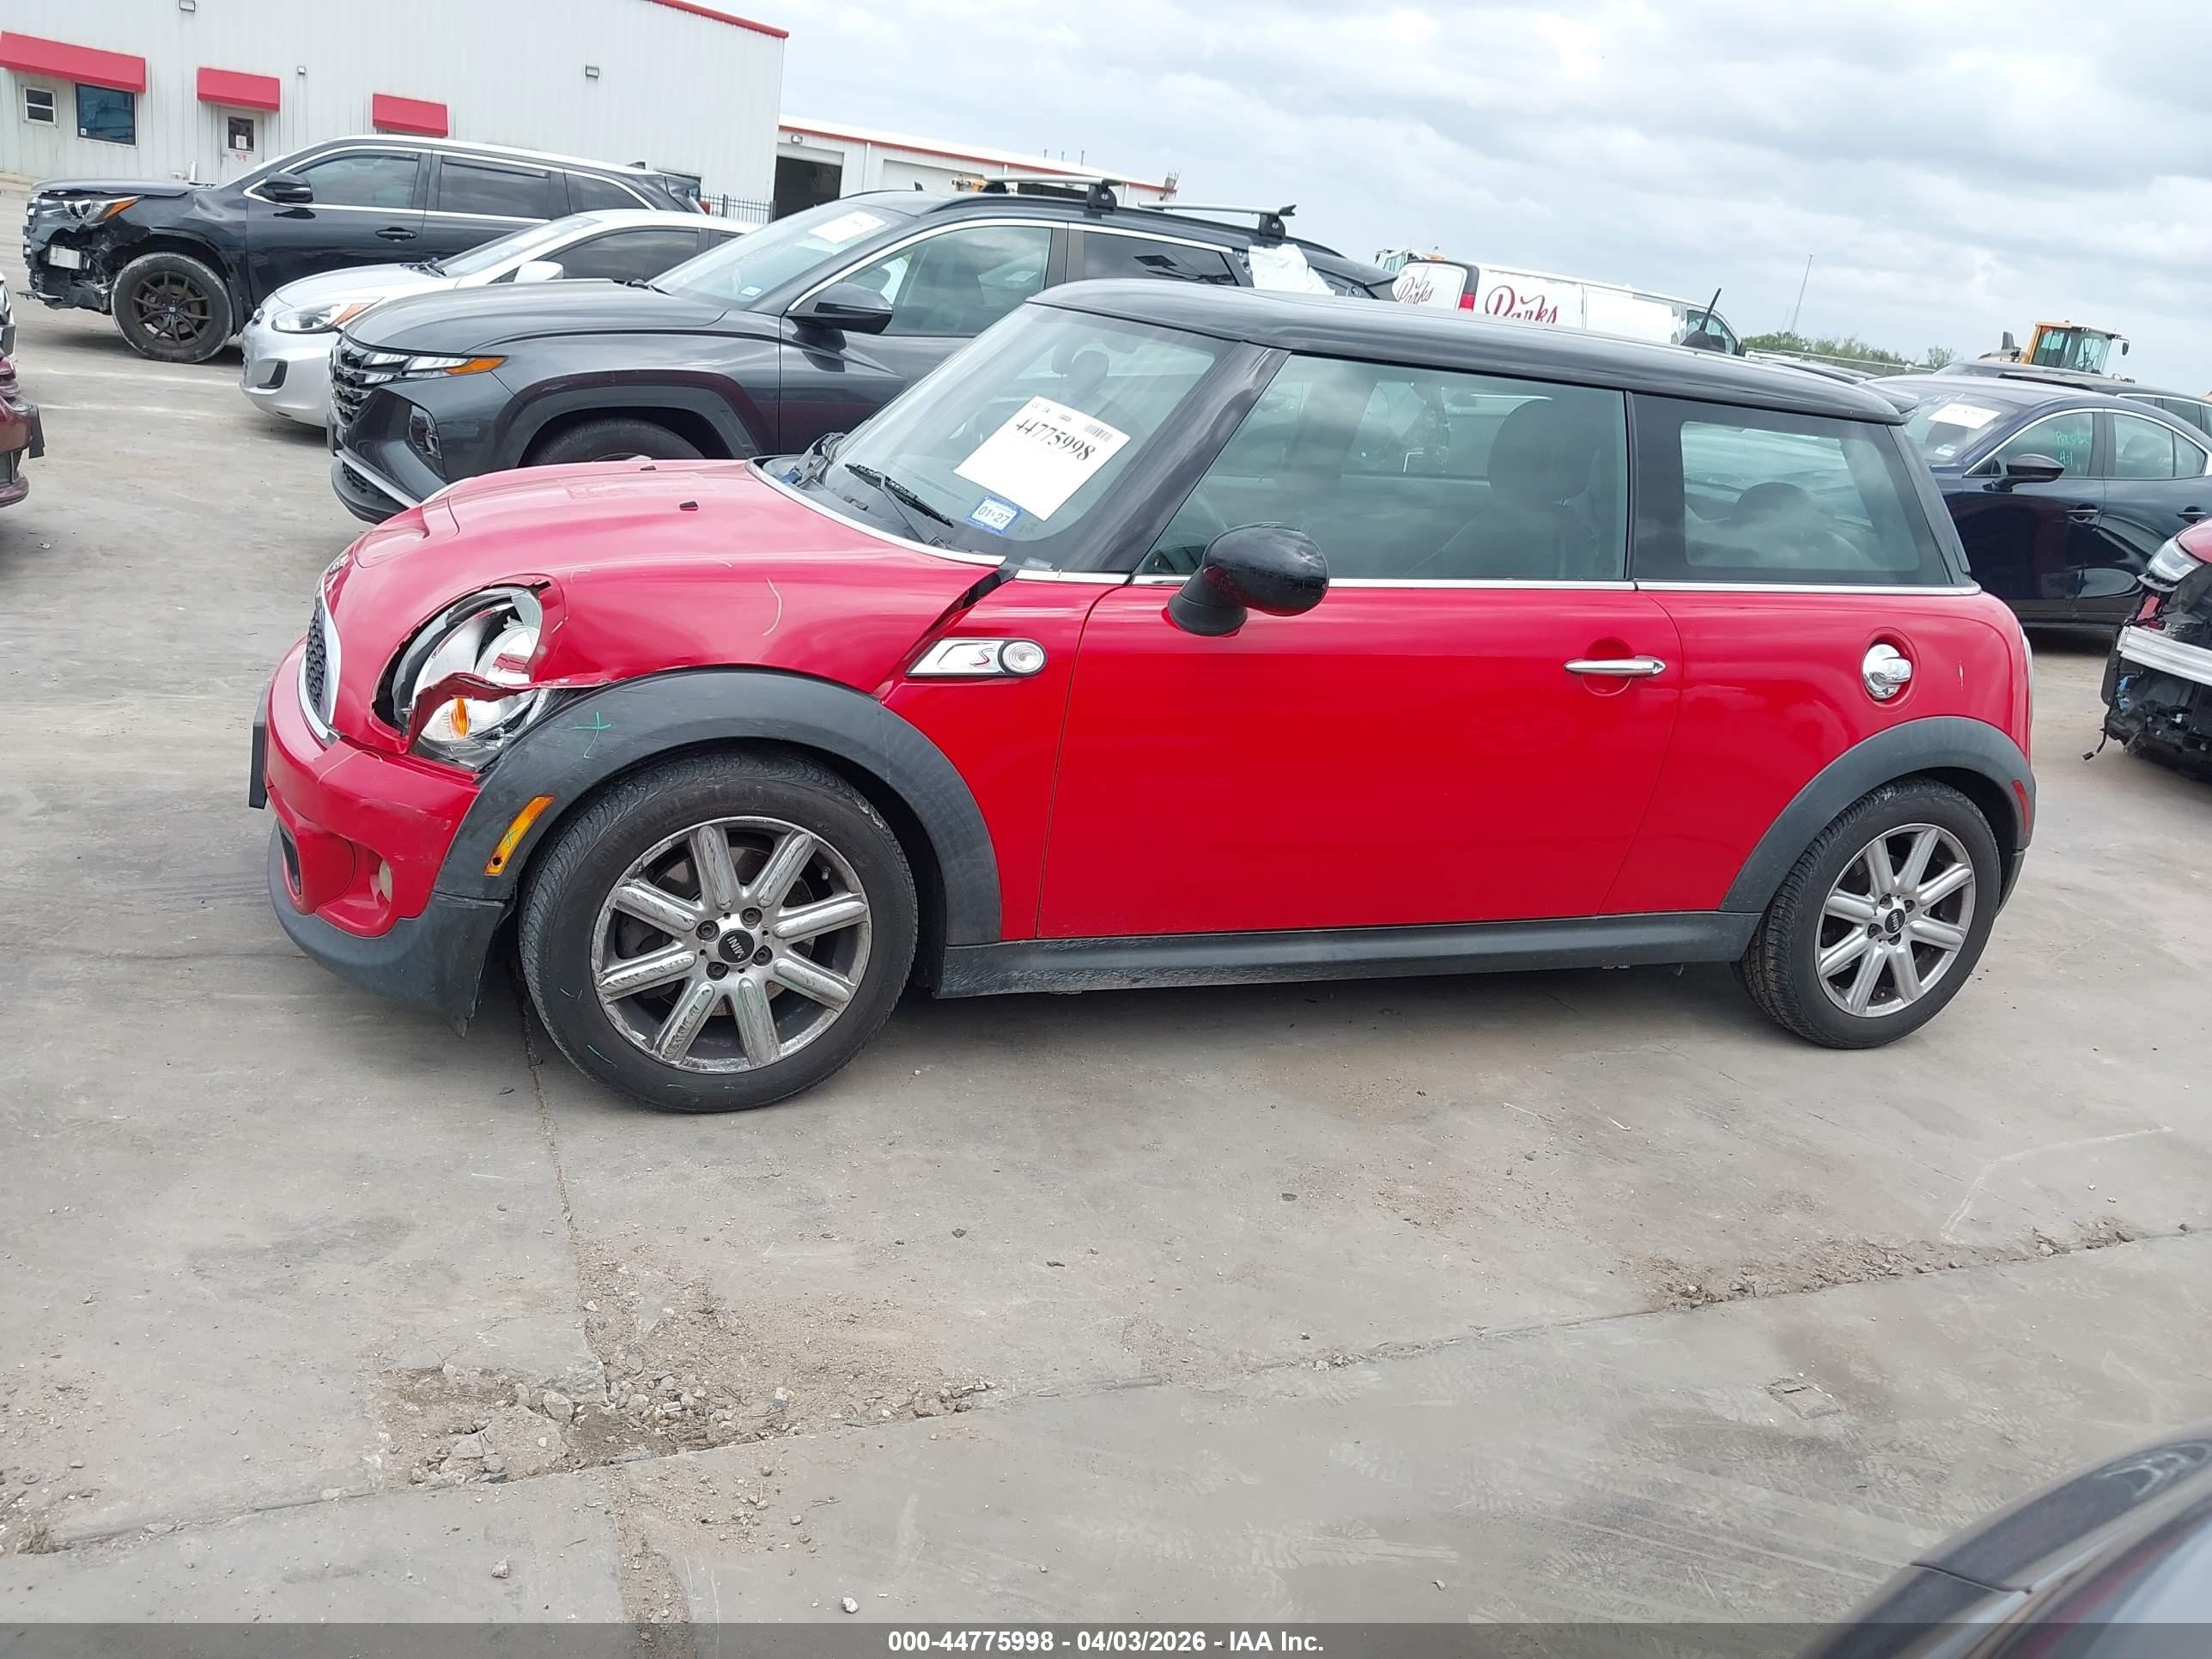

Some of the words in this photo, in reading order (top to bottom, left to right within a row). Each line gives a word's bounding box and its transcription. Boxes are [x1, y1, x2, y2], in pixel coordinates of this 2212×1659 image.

[1017, 417, 1096, 460] 44775998
[969, 647, 995, 667] S
[726, 935, 745, 959] MINI
